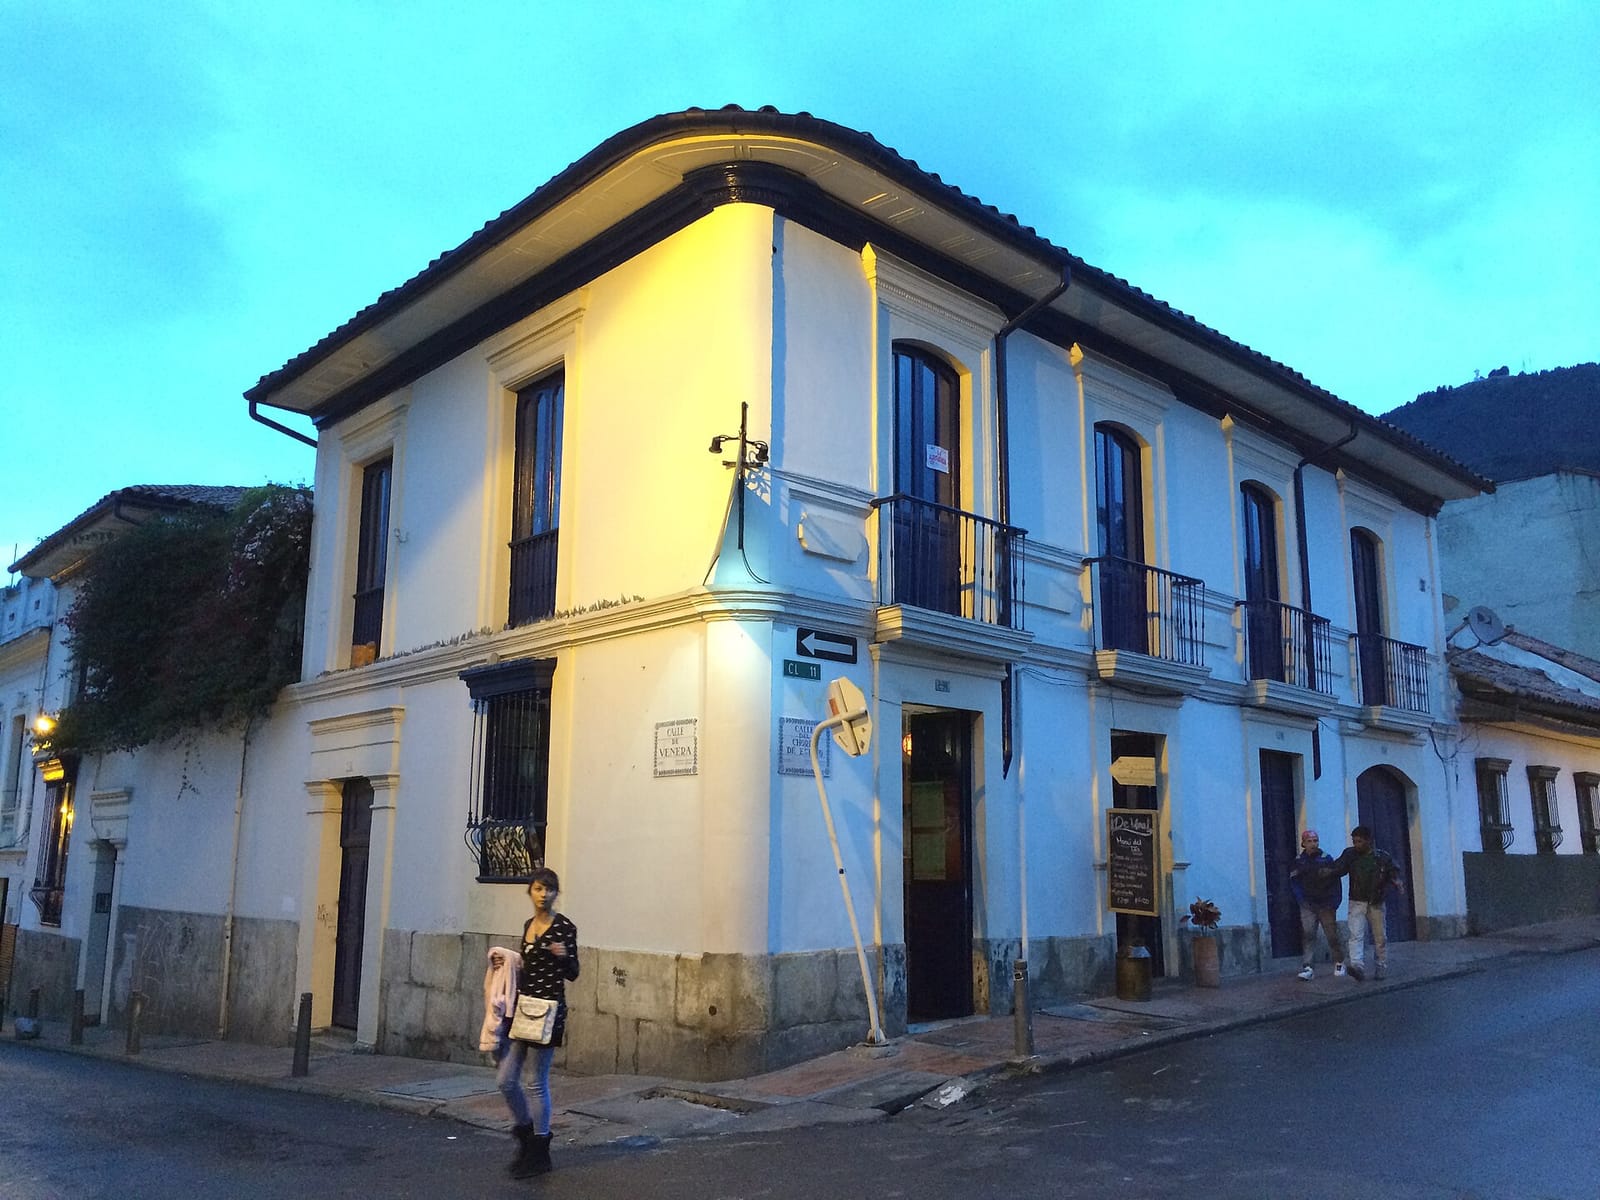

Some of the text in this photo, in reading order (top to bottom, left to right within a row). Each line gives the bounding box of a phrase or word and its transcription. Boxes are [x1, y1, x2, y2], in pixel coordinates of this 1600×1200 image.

[788, 663, 817, 677] CL 11
[666, 727, 684, 736] CALLE
[795, 725, 813, 733] CALLE
[659, 746, 692, 757] VENERA
